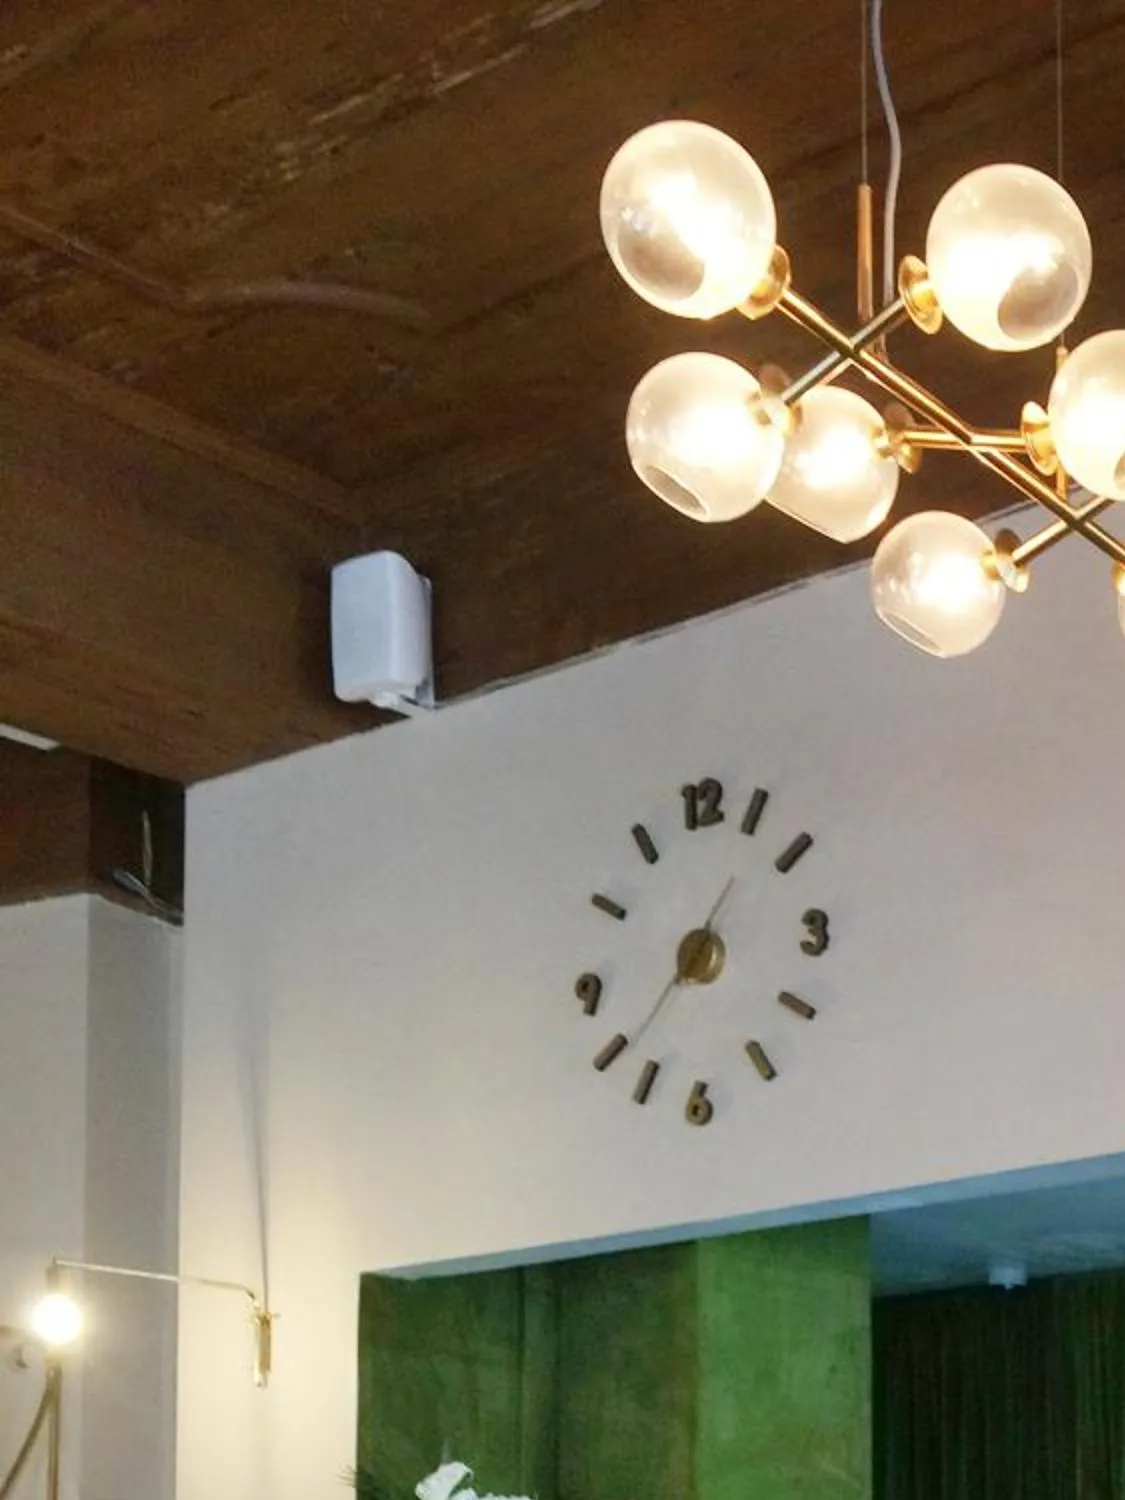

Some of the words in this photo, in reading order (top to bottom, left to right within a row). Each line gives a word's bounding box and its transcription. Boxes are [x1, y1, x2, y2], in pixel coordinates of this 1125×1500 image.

[681, 777, 725, 831] 12
[799, 908, 830, 957] 3
[575, 972, 603, 1017] 9
[685, 1079, 714, 1126] 6
